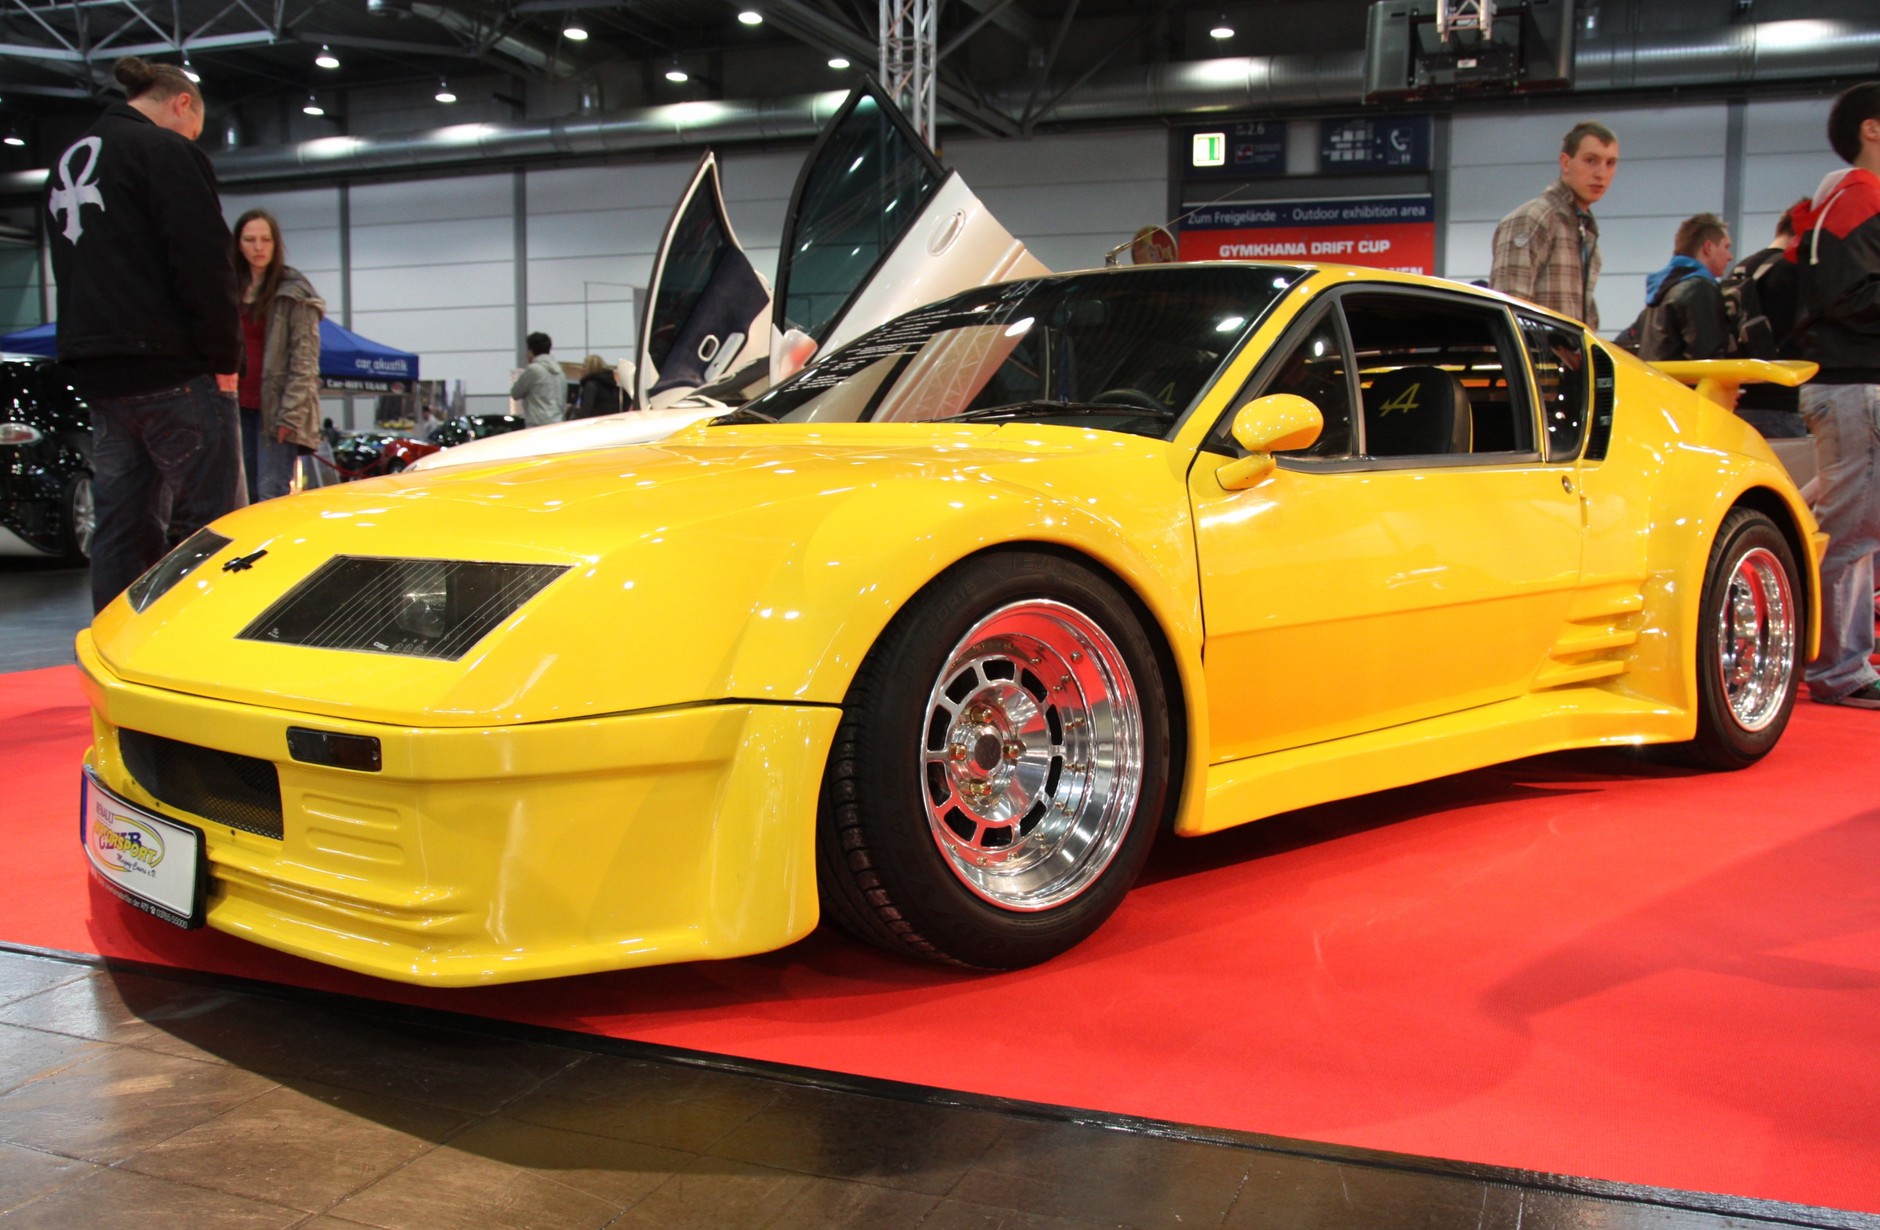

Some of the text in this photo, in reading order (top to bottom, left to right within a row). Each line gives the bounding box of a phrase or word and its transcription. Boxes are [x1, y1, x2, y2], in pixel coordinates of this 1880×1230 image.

[1188, 205, 1426, 226] Zum Freigelände Outdoor exhibition area
[1219, 239, 1391, 258] GYMKHANA DRIFT CUP
